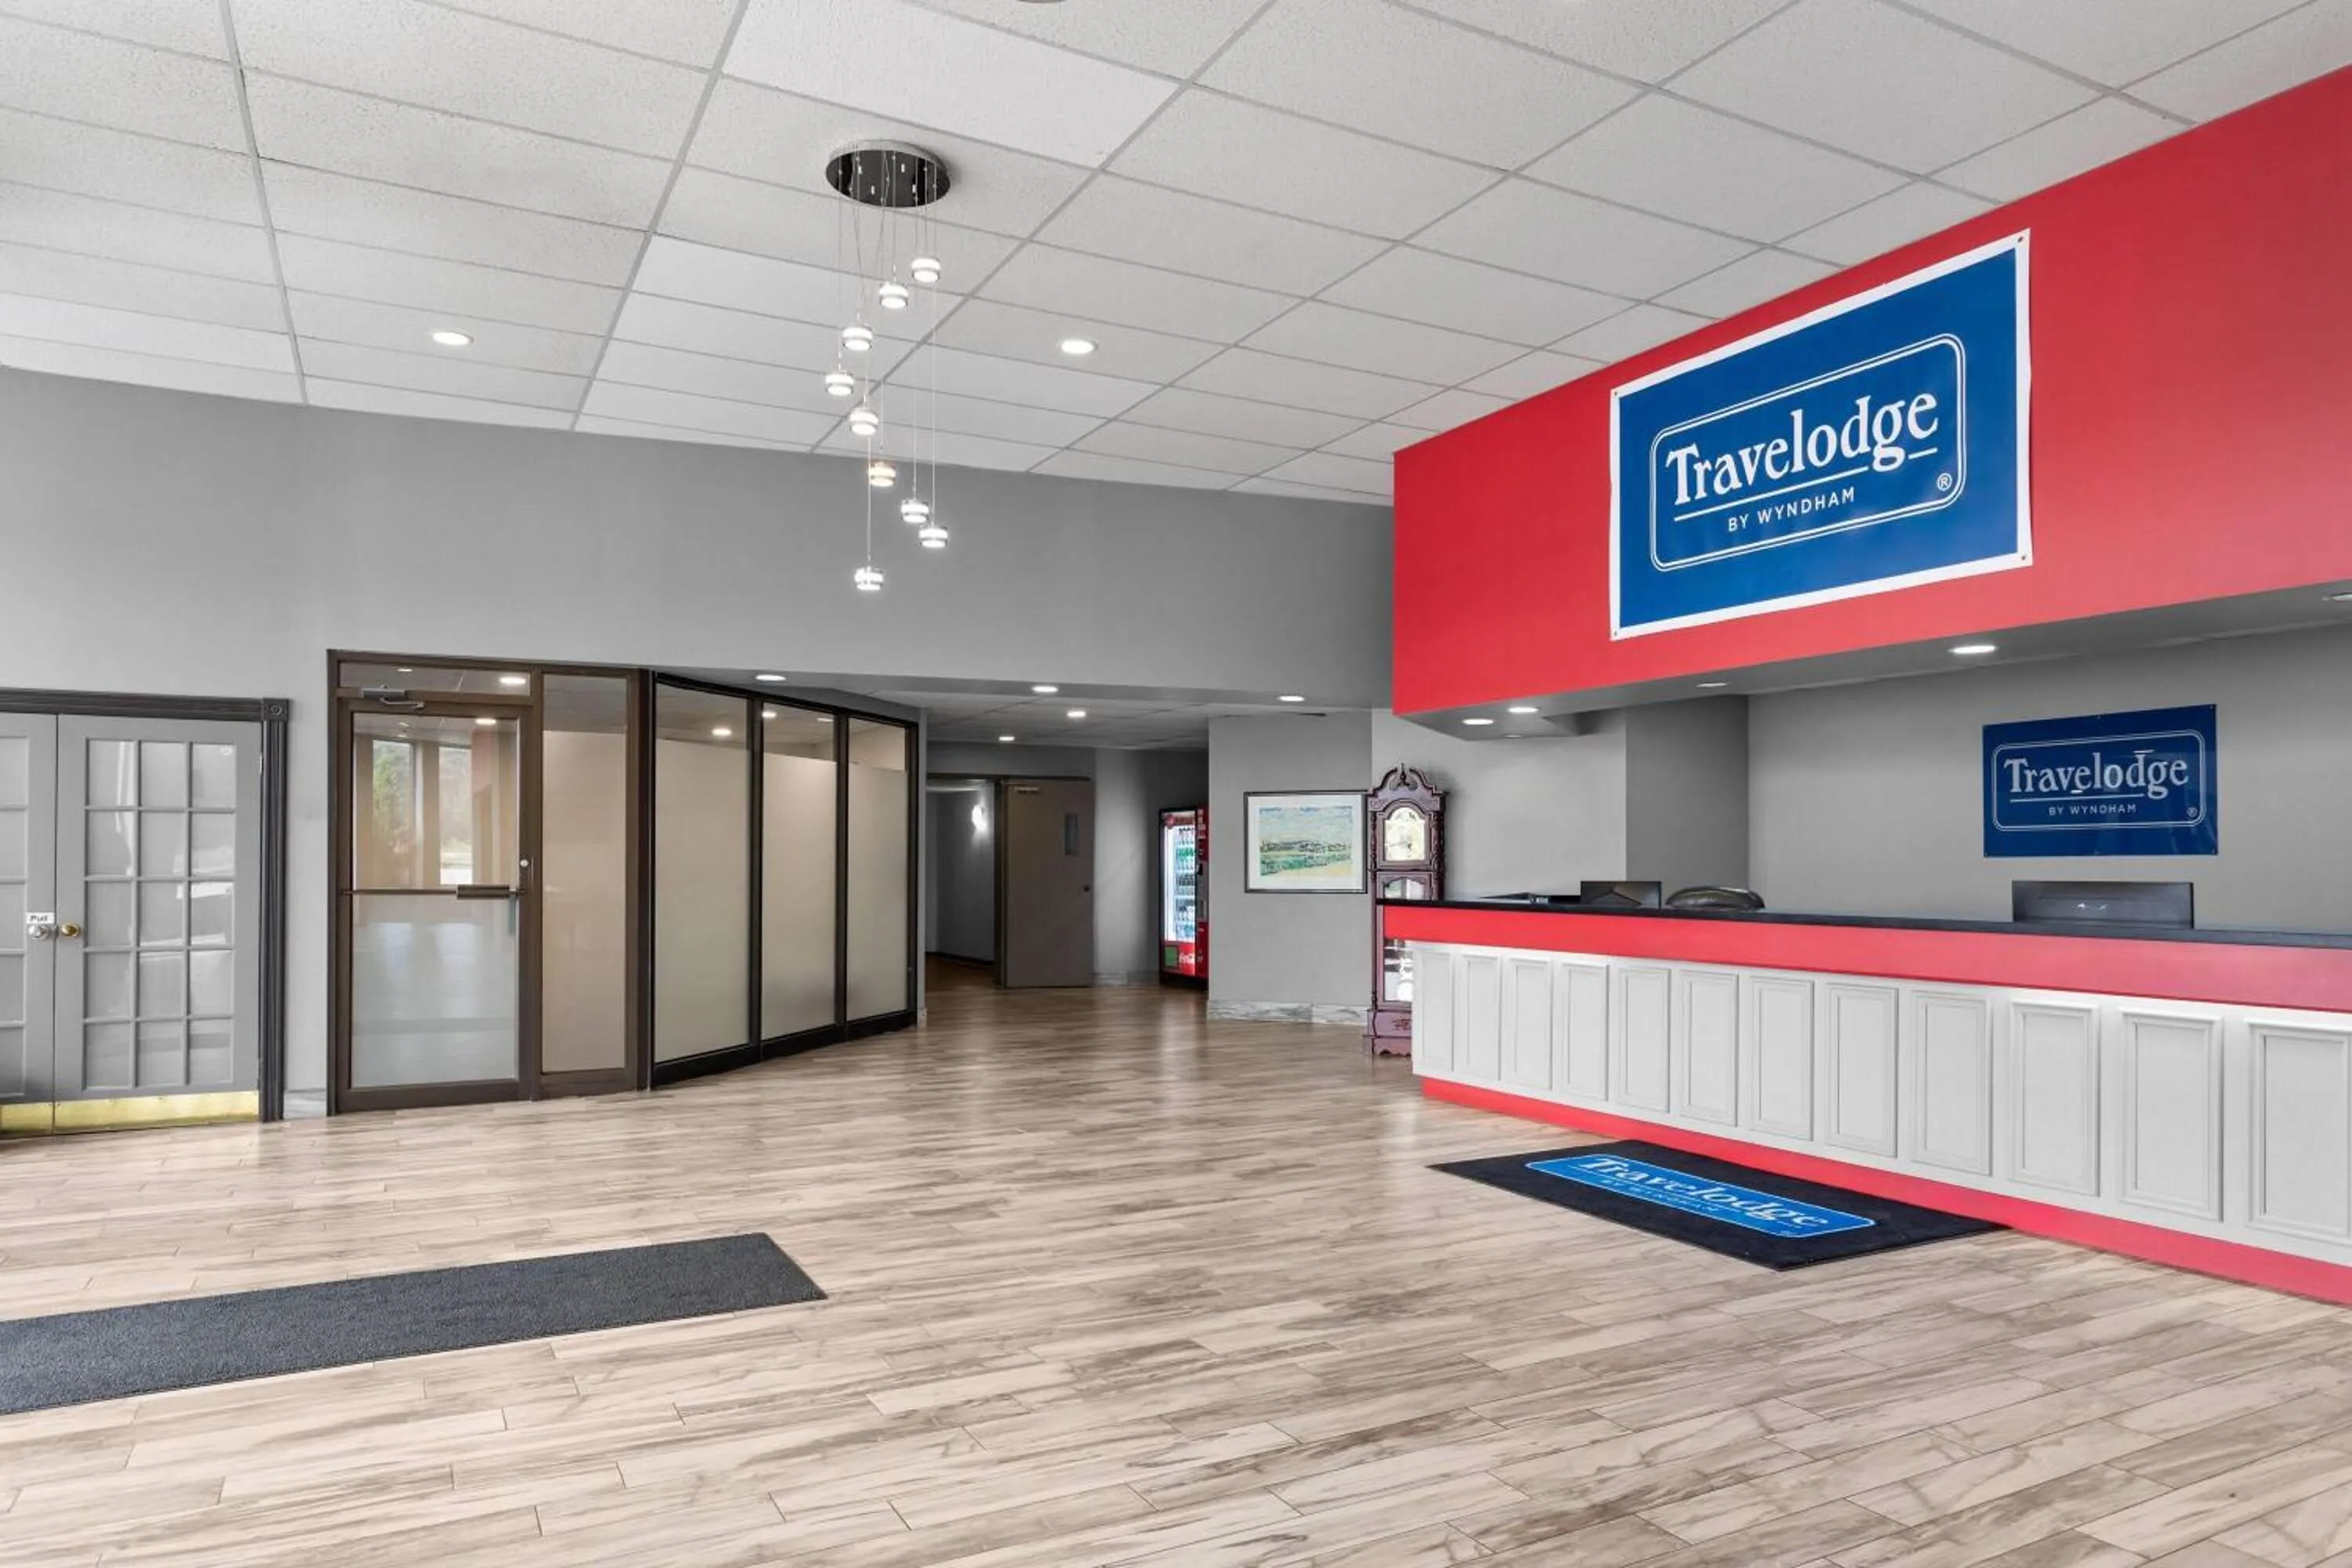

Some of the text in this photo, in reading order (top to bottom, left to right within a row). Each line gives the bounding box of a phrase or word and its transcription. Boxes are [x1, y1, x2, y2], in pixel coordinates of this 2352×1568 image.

[1665, 393, 1939, 506] Travelodge
[1728, 487, 1856, 532] BY WYNDHAM
[2003, 752, 2189, 800] Travelodge
[2048, 804, 2137, 816] BY WYNDHAM
[1579, 1158, 1829, 1229] Travelodge
